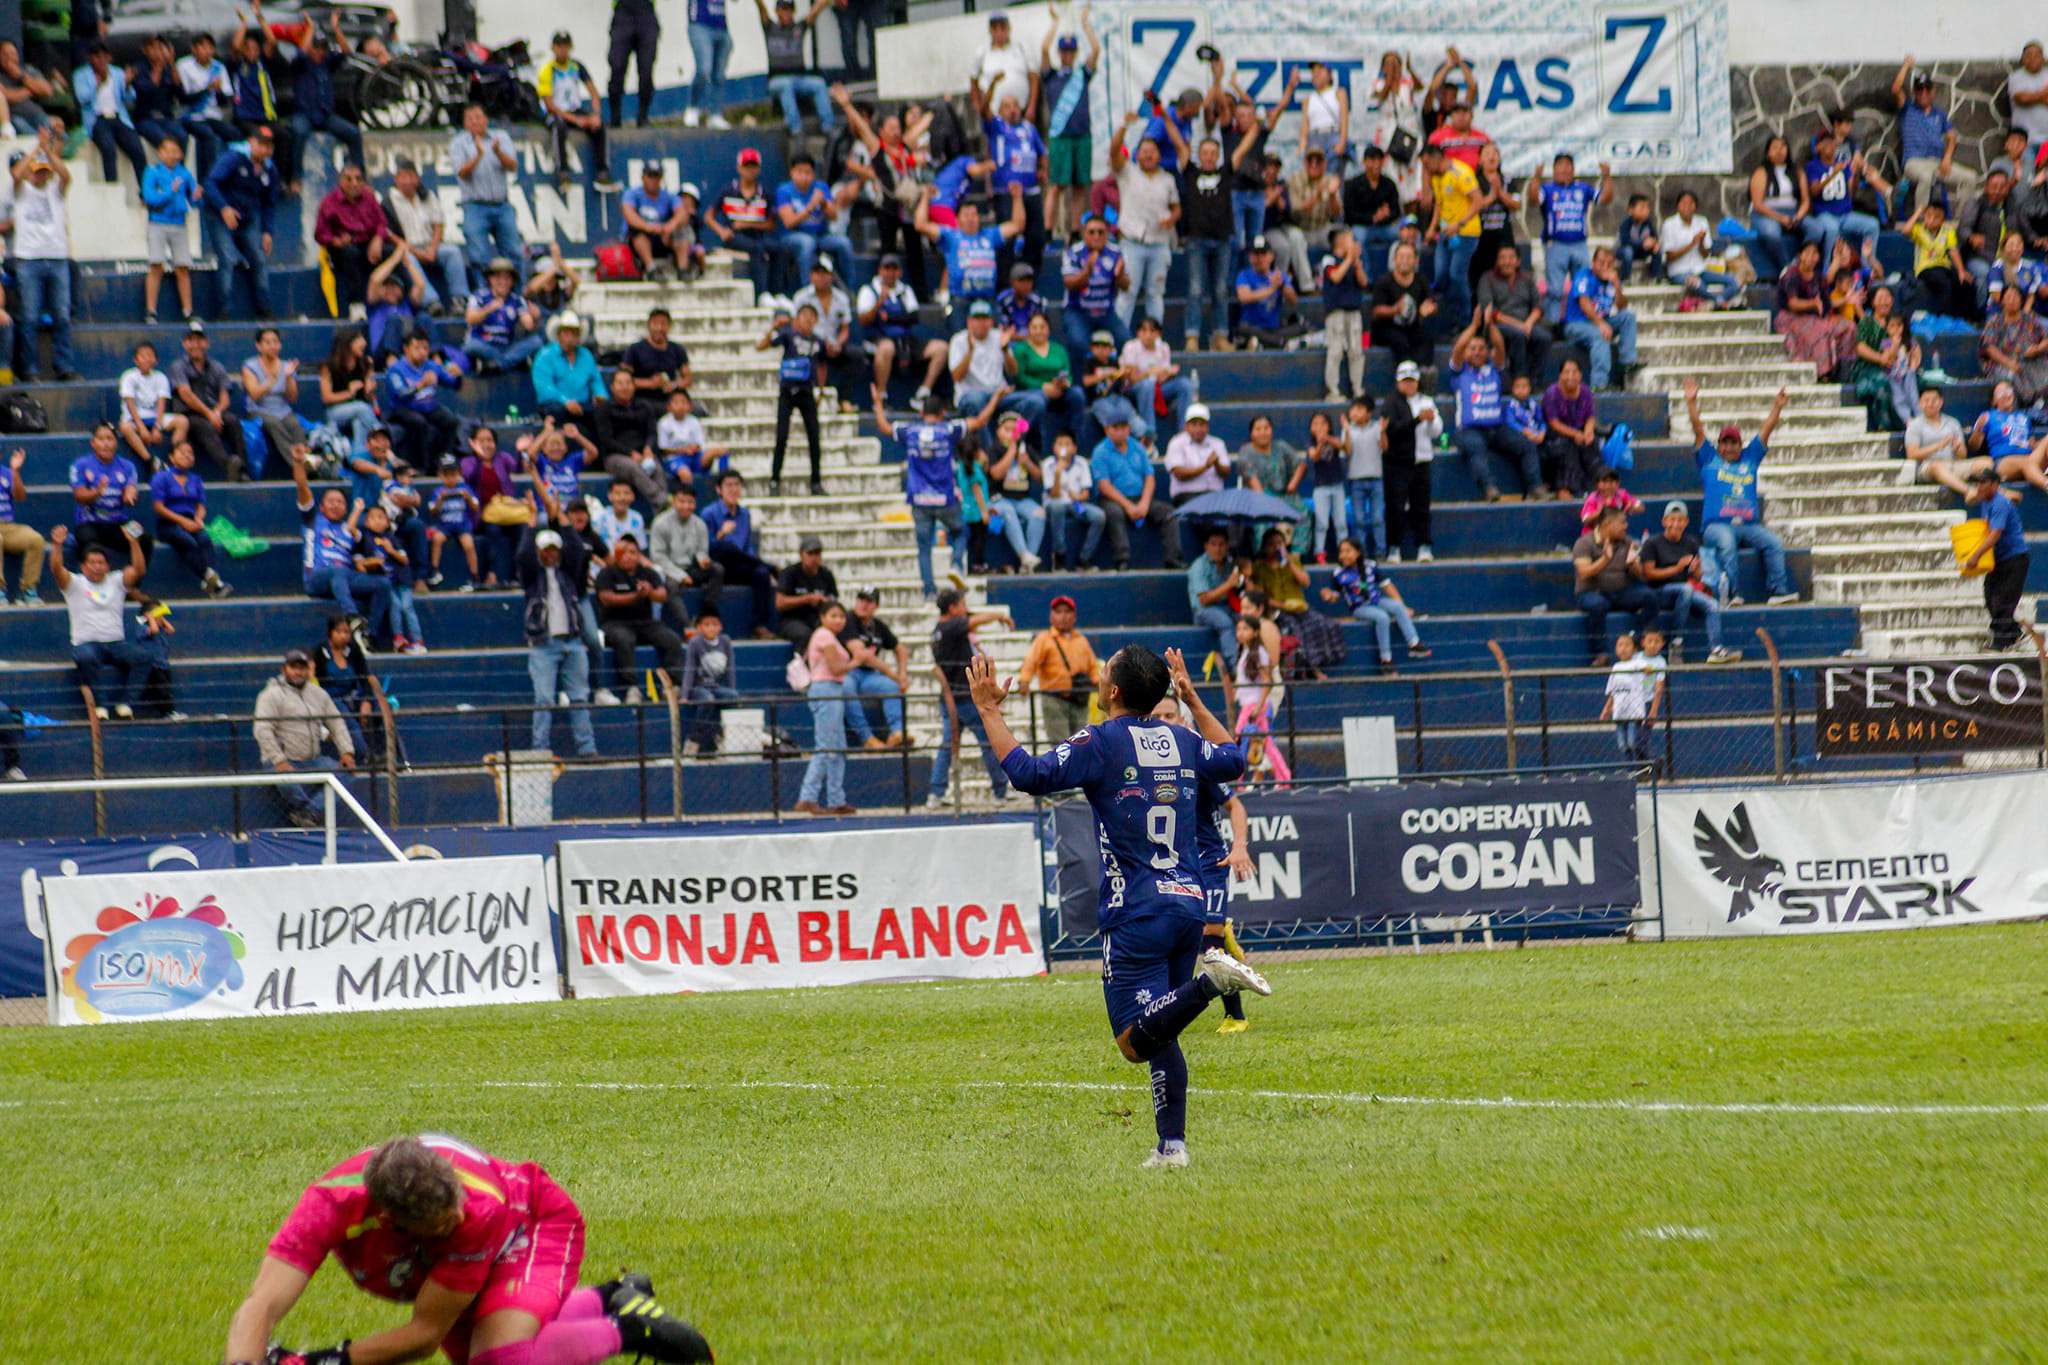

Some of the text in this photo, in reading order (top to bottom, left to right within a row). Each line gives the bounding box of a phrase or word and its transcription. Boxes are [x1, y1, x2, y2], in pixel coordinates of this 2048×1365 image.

[1604, 15, 1672, 113] Z
[1611, 140, 1672, 159] GAS
[1824, 663, 2028, 710] FERCO
[1139, 734, 1171, 758] tigo
[1826, 717, 1979, 743] CERÁMICA
[1147, 805, 1180, 869] 9
[1221, 815, 1299, 842] AIVA
[1400, 801, 1592, 835] COOPERATIVA
[1401, 827, 1596, 894] COBÁN
[1796, 853, 1950, 881] CEMENTO
[571, 872, 859, 905] TRANSPORTES
[1205, 889, 1226, 913] 17
[1778, 876, 1983, 925] STARK
[278, 886, 531, 952] HIDRATACION
[575, 903, 1034, 966] MONJA BLANCA
[254, 941, 542, 1010] AL MAXIMO!
